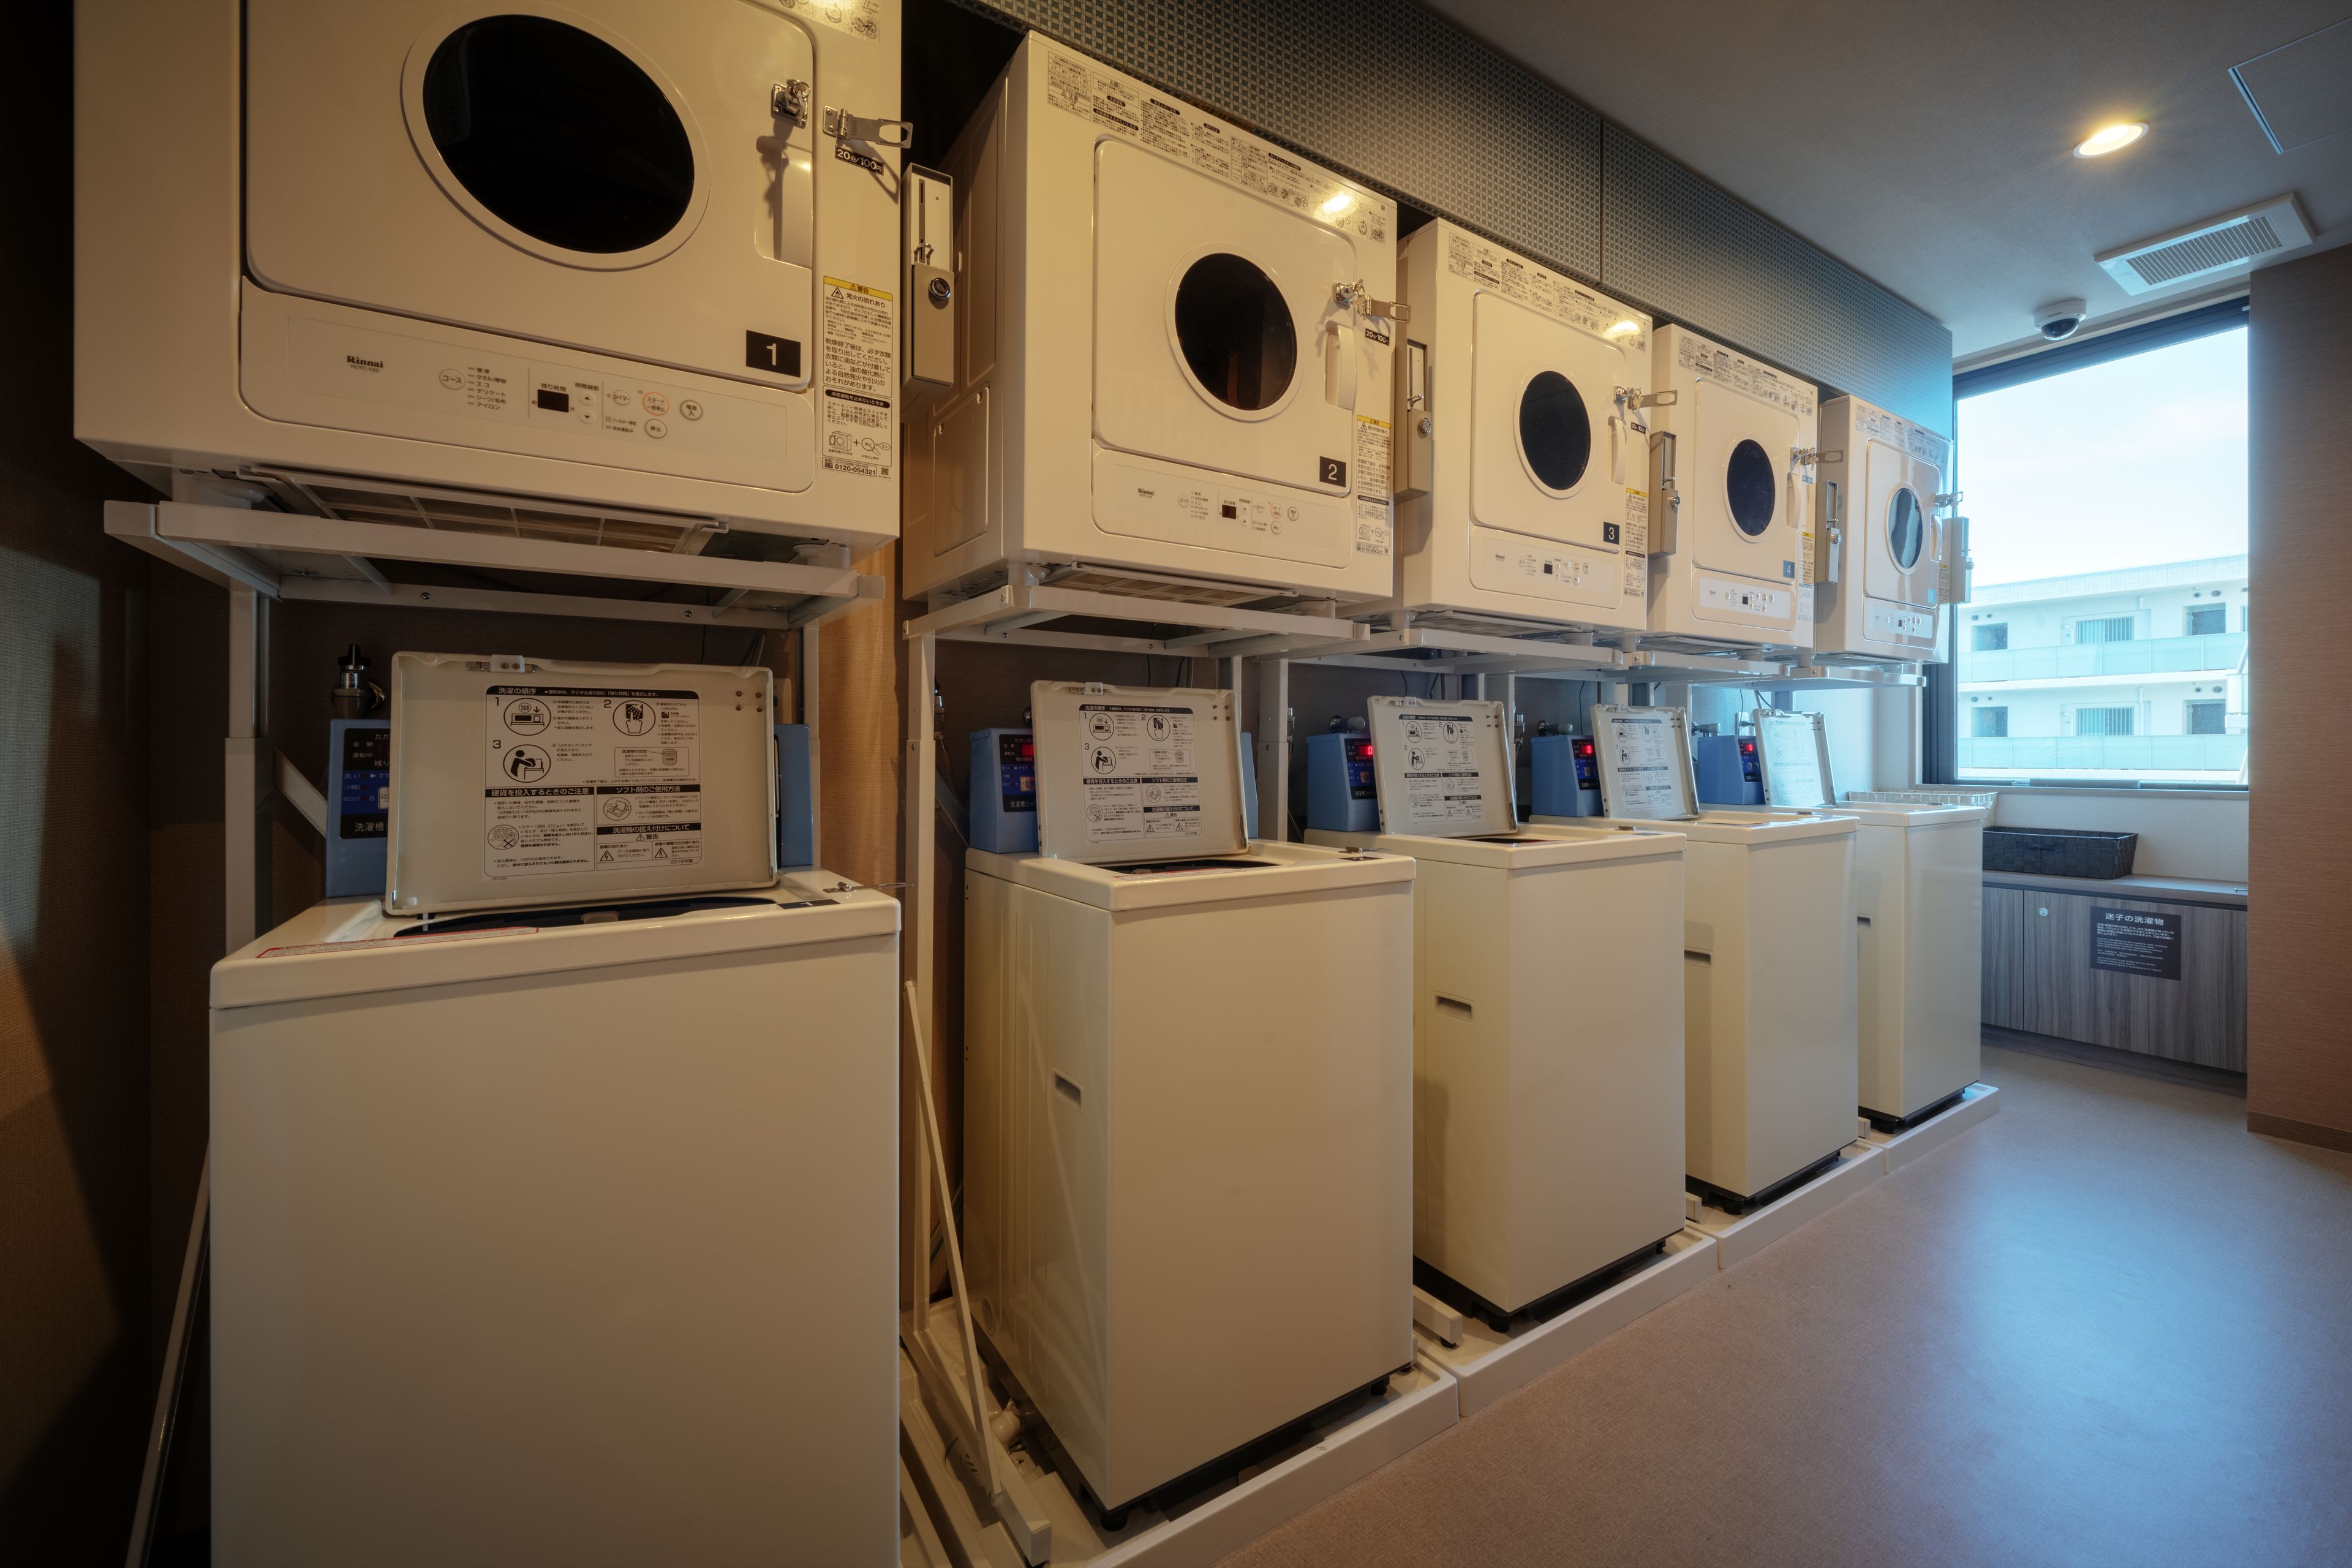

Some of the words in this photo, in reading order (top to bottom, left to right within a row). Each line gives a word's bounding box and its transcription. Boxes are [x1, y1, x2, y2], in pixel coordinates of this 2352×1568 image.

[837, 149, 882, 172] 20分/100円
[858, 285, 869, 294] 警告
[846, 293, 886, 307] 発火の恐れあり
[825, 338, 891, 358] 乾燥終了後は、必ず衣類
[766, 343, 777, 366] 1
[825, 345, 889, 365] を取り出してください。
[346, 355, 384, 368] Rinnai
[825, 353, 891, 372] 衣類に油などが付着して
[825, 361, 886, 379] いると、油の酸化熱に
[443, 375, 462, 384] コース
[825, 368, 886, 386] よる自然発火や引火の
[541, 382, 567, 392] 残り時間
[575, 382, 599, 391] 時間調節
[825, 376, 876, 392] おそれがあります。
[477, 388, 507, 398] デリケート
[831, 391, 884, 406] 冷却運転を止めたいときは
[835, 464, 876, 475] 0120-054321
[1328, 464, 1338, 481] 2
[1608, 527, 1615, 540] 3
[1786, 564, 1792, 575] 4
[494, 697, 499, 706] 1
[603, 699, 612, 708] 2
[492, 739, 502, 749] 3
[1368, 746, 1373, 755] 0
[612, 824, 690, 834] 洗濯機の据え付けについて
[2105, 913, 2164, 925] 迷子の洗濯物
